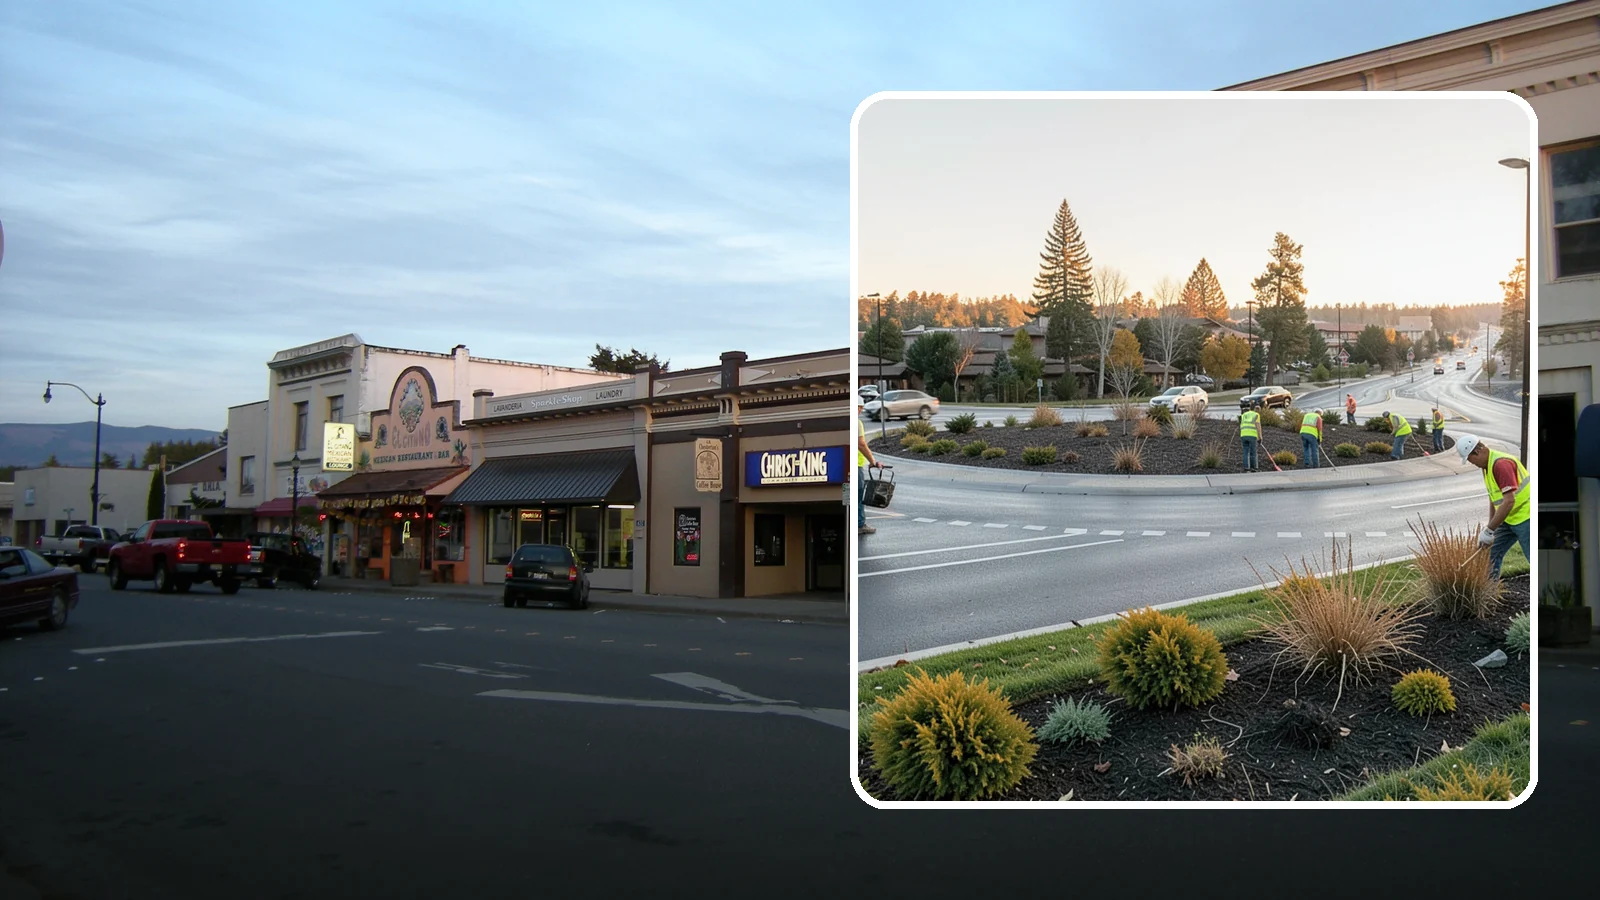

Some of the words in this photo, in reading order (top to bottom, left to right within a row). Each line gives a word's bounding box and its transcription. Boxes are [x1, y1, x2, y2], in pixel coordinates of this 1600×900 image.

[531, 396, 561, 408] Sparkle
[562, 394, 582, 404] Shop
[596, 389, 624, 400] LAUNDRY
[494, 402, 522, 412] LAVANDERIA
[392, 425, 402, 449] EL
[374, 454, 396, 464] MEXICAN
[397, 451, 434, 463] RESTAURANT
[438, 450, 450, 459] BAR
[760, 452, 798, 478] CHRIST
[799, 450, 828, 476] KING
